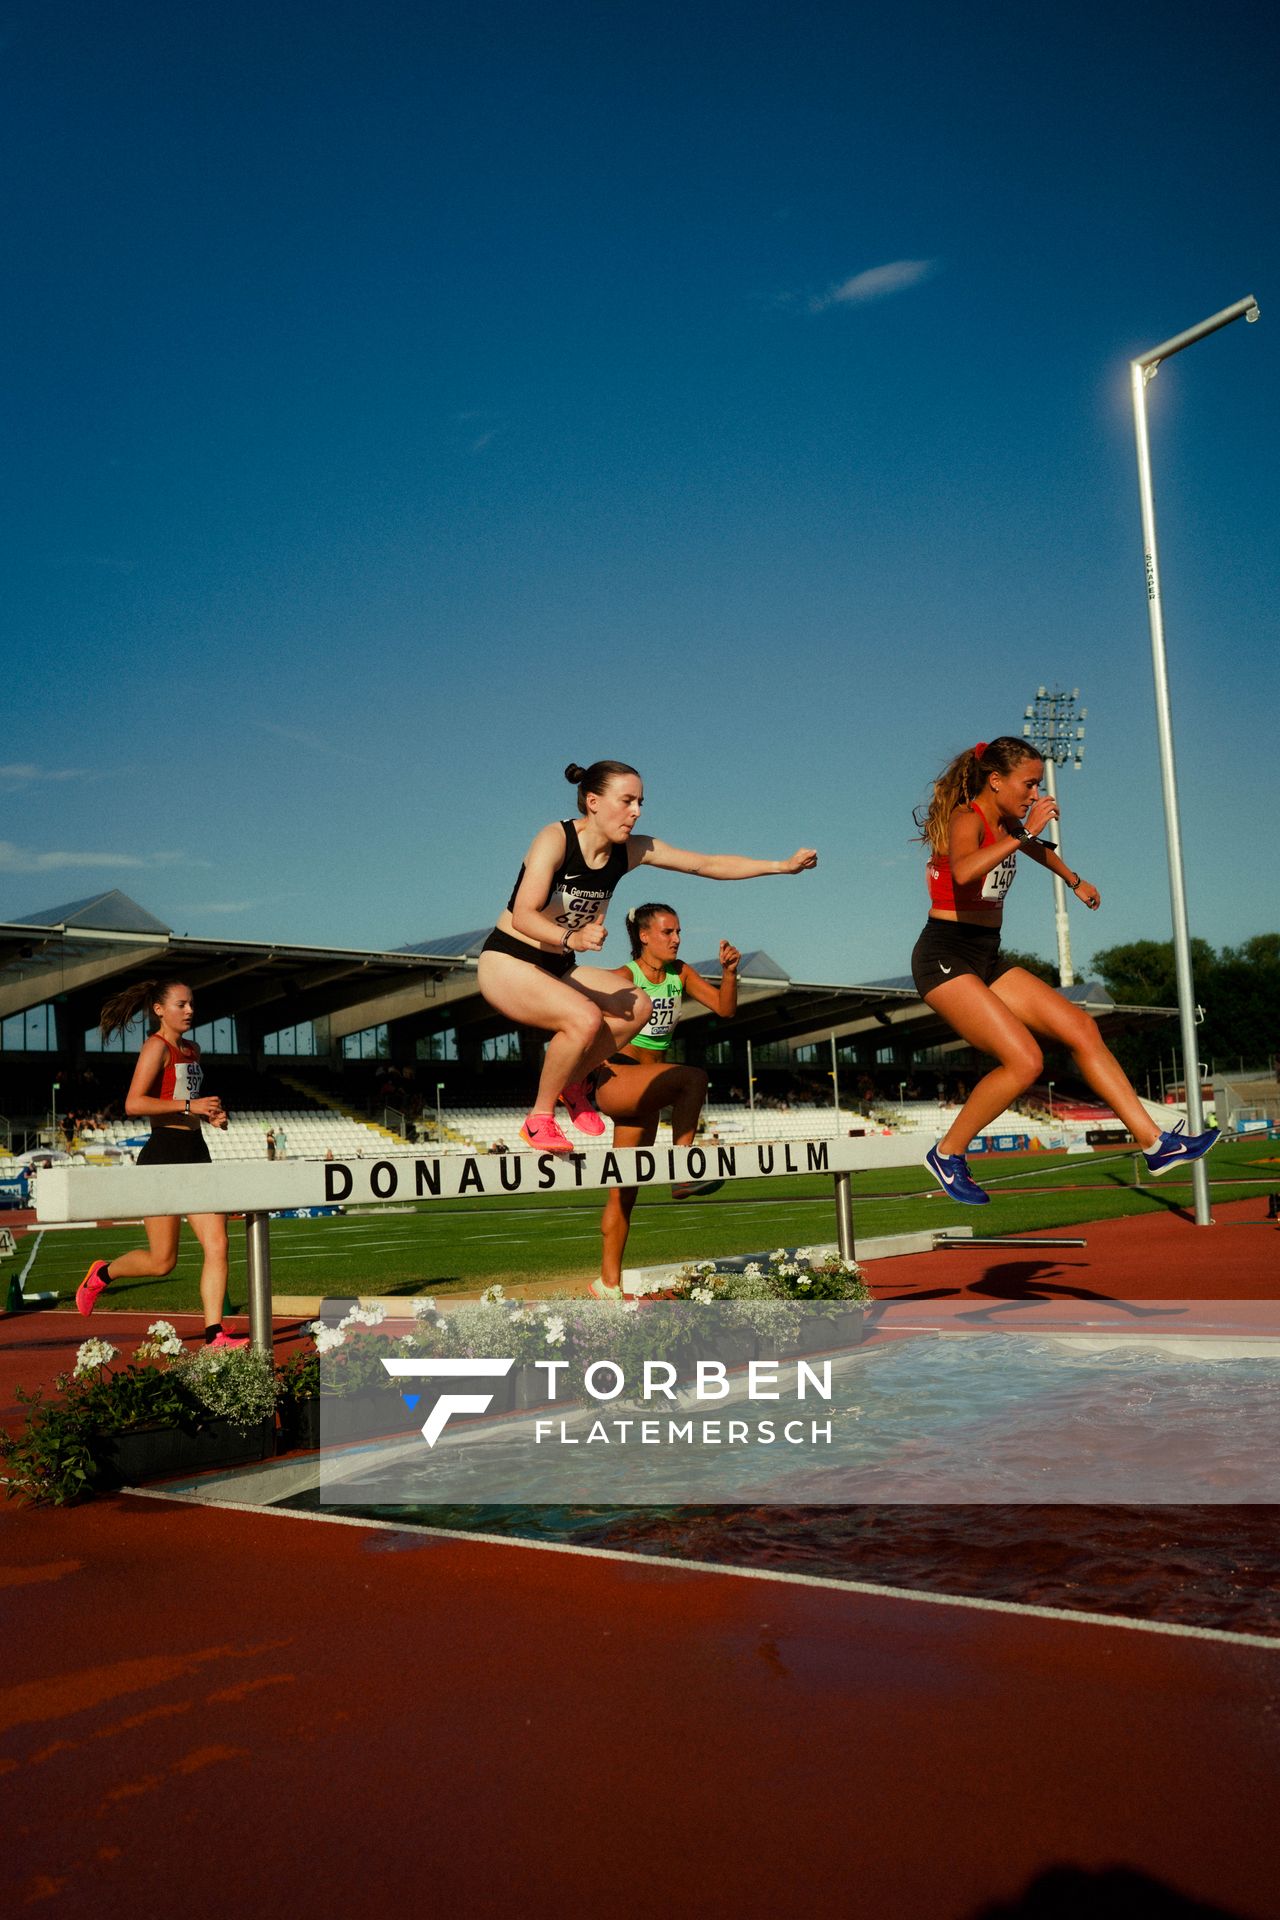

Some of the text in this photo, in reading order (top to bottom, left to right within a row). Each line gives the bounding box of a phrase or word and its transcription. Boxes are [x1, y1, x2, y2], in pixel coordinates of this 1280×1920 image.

[1145, 554, 1156, 600] SCHAPER
[571, 886, 605, 898] Germania
[568, 898, 601, 913] GLS
[652, 998, 675, 1009] GLS
[648, 1010, 674, 1026] 871
[324, 1142, 830, 1202] DONAUSTADION ULM
